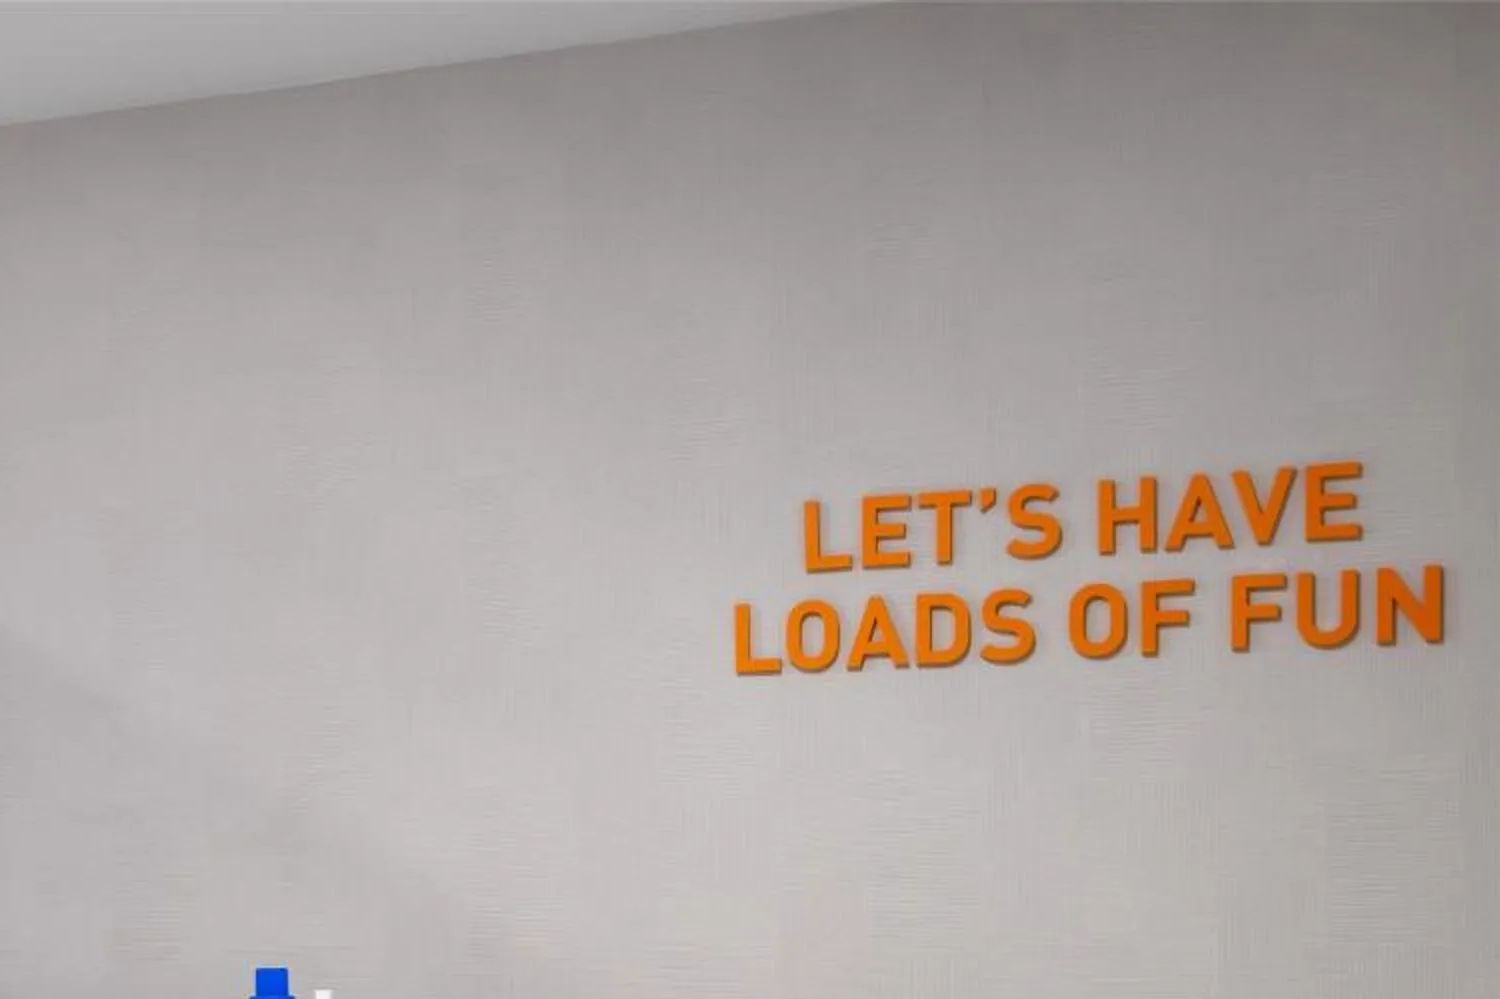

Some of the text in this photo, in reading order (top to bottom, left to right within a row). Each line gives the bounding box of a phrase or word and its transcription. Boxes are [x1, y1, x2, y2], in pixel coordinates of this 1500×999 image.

[804, 461, 1363, 573] LET’S HAVE
[735, 564, 1444, 674] LOADS OF FUN
